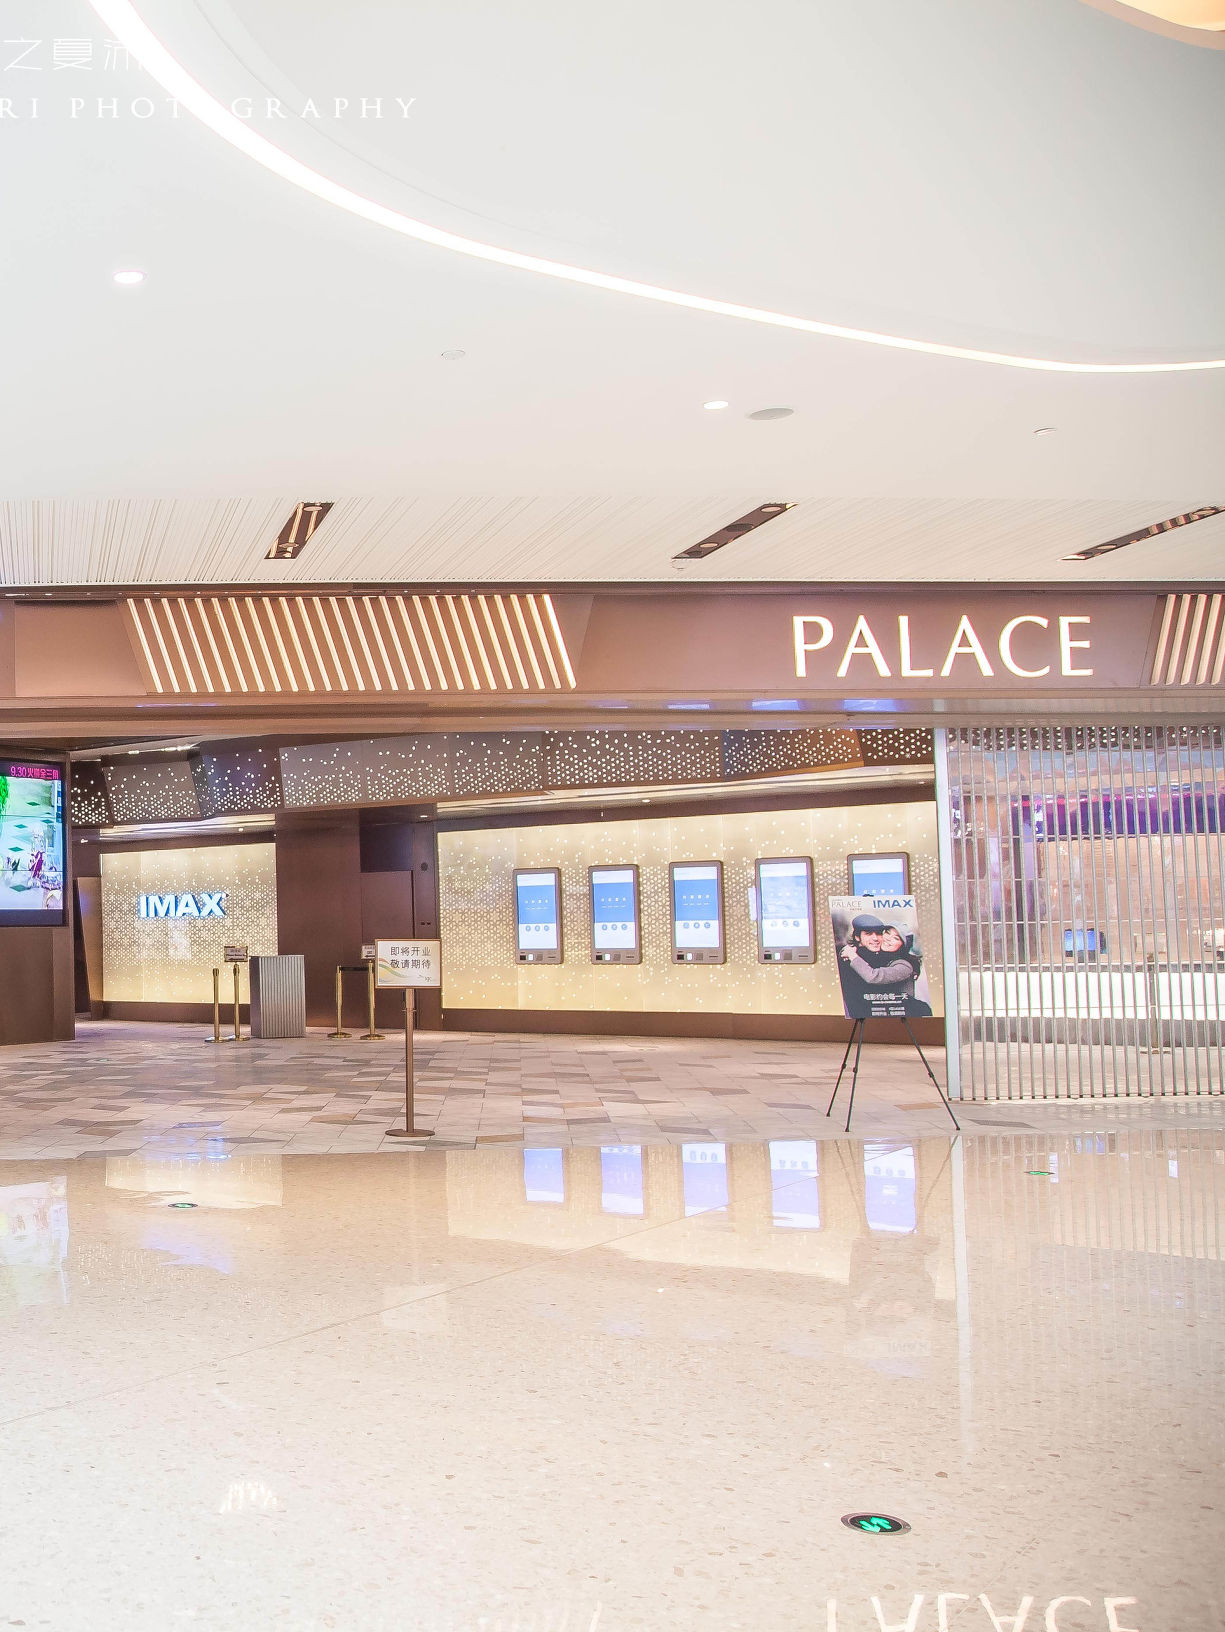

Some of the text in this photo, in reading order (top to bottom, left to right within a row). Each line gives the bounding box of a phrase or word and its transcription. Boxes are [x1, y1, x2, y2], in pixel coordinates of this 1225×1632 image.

[792, 614, 1094, 678] PALACE
[138, 891, 226, 918] IMAX
[872, 899, 913, 909] IMAX
[389, 946, 432, 957] 即将开业
[389, 958, 432, 969] 敬请期待
